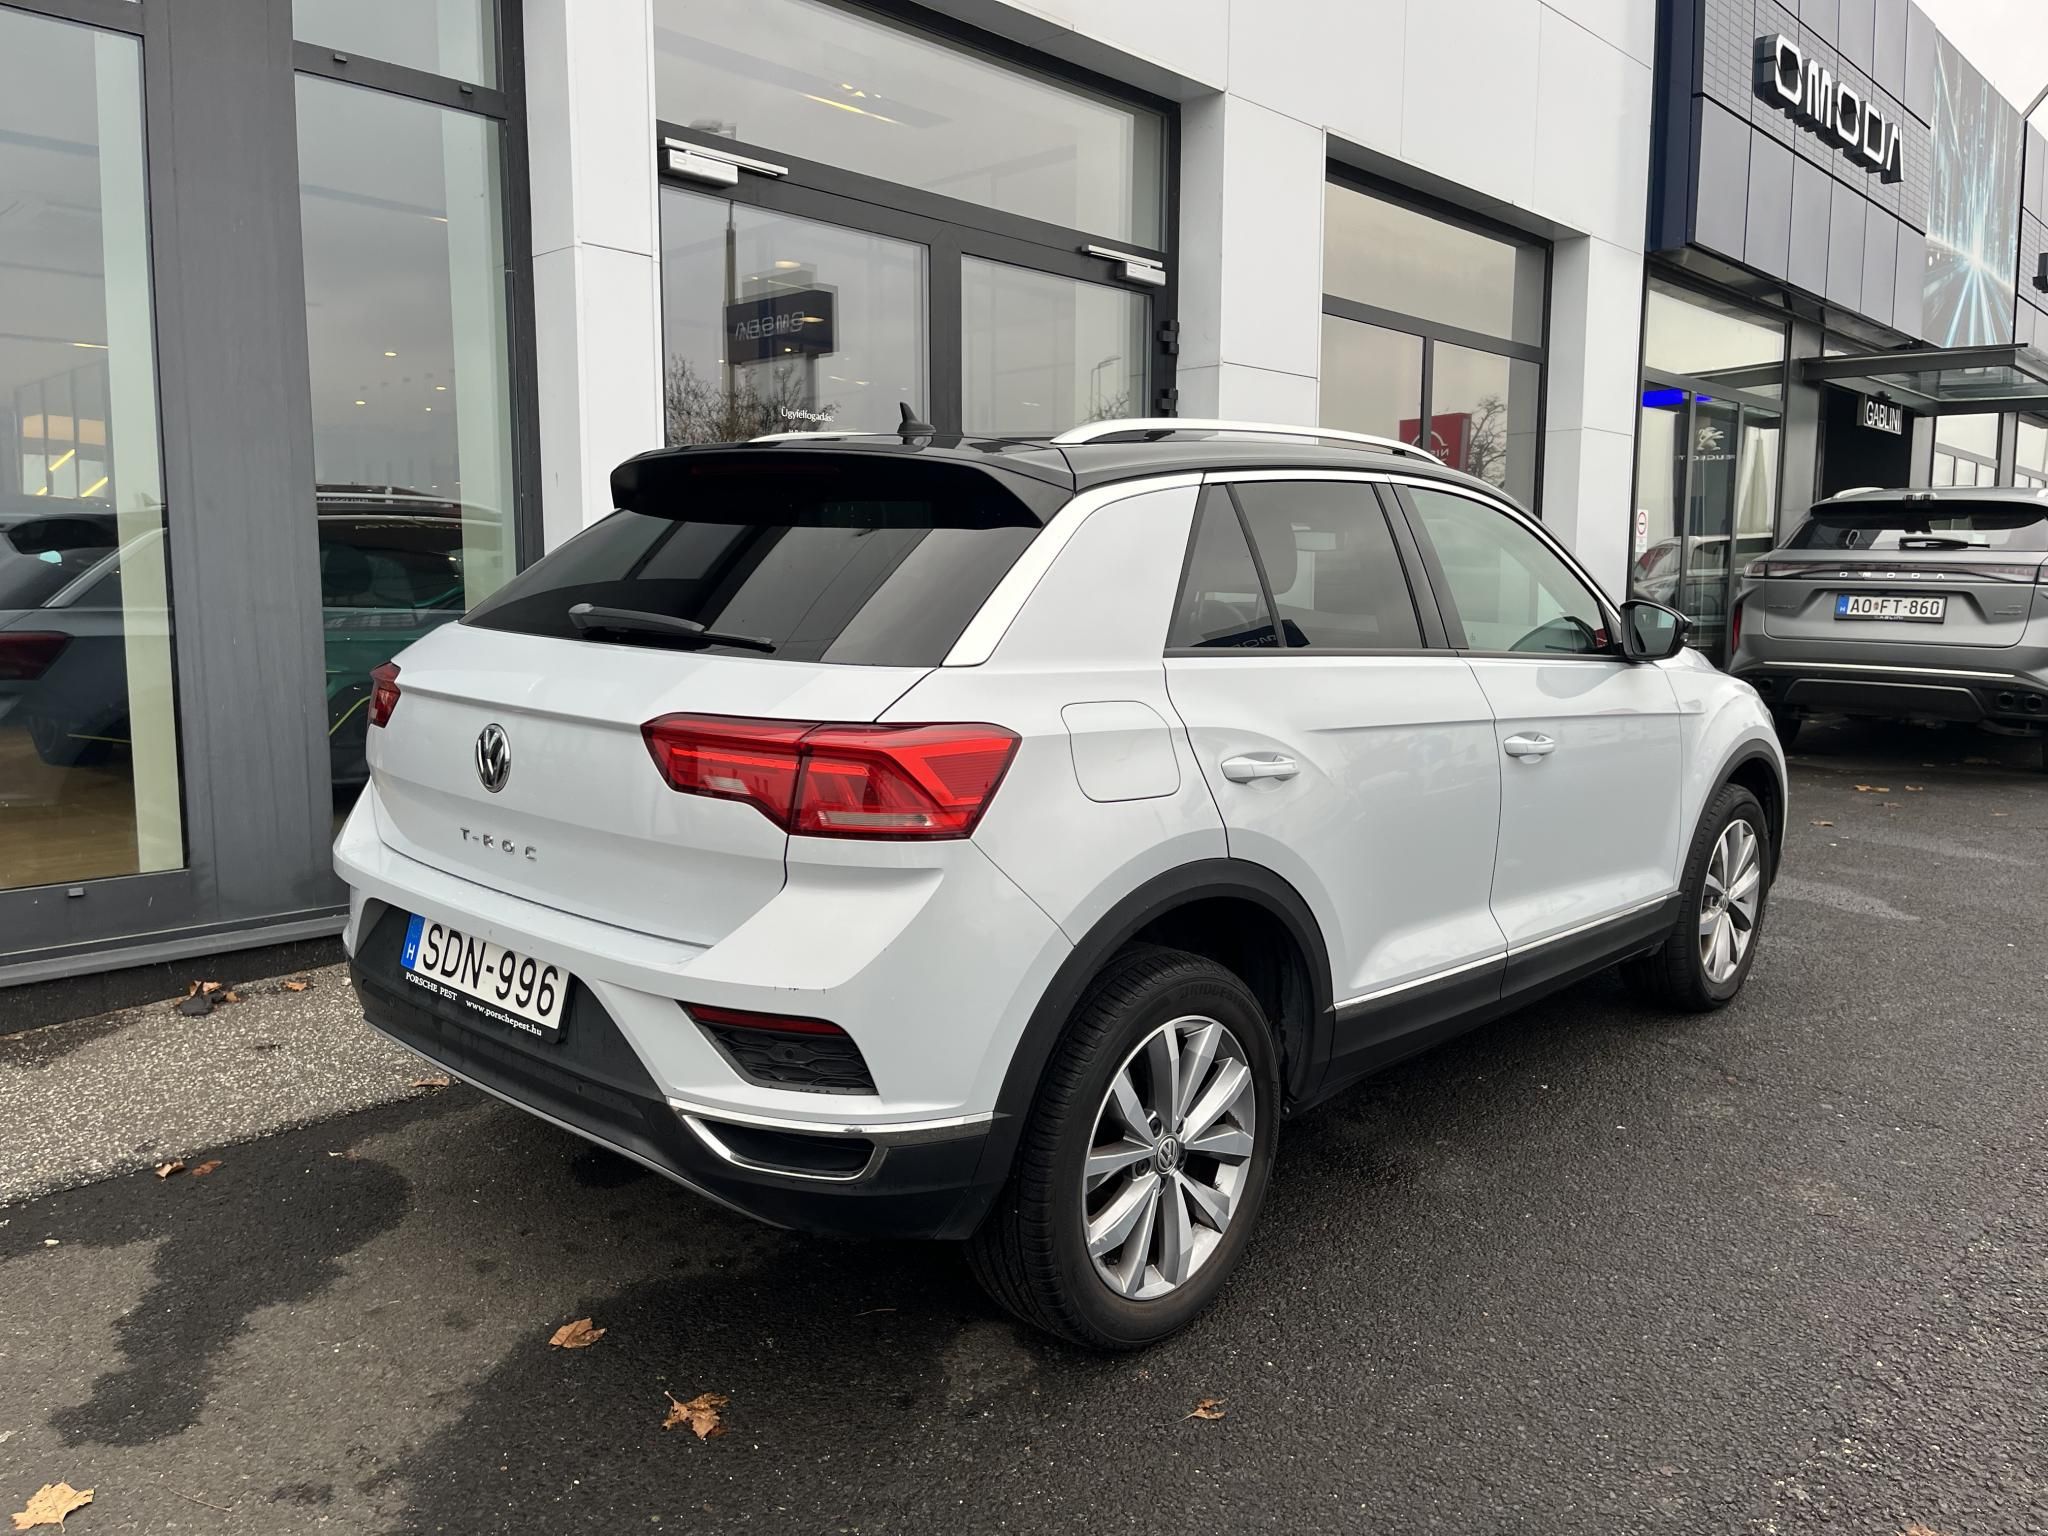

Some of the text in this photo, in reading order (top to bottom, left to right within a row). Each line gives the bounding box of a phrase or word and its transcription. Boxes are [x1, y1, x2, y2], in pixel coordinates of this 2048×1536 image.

[1774, 33, 1904, 181] OMODA
[1866, 401, 1901, 432] GABLINI
[1850, 598, 1940, 615] AO FT-860
[406, 943, 416, 960] H
[422, 923, 559, 1017] SDN-996
[405, 972, 542, 1036] PORSCHE PEST www.porschepest.hu
